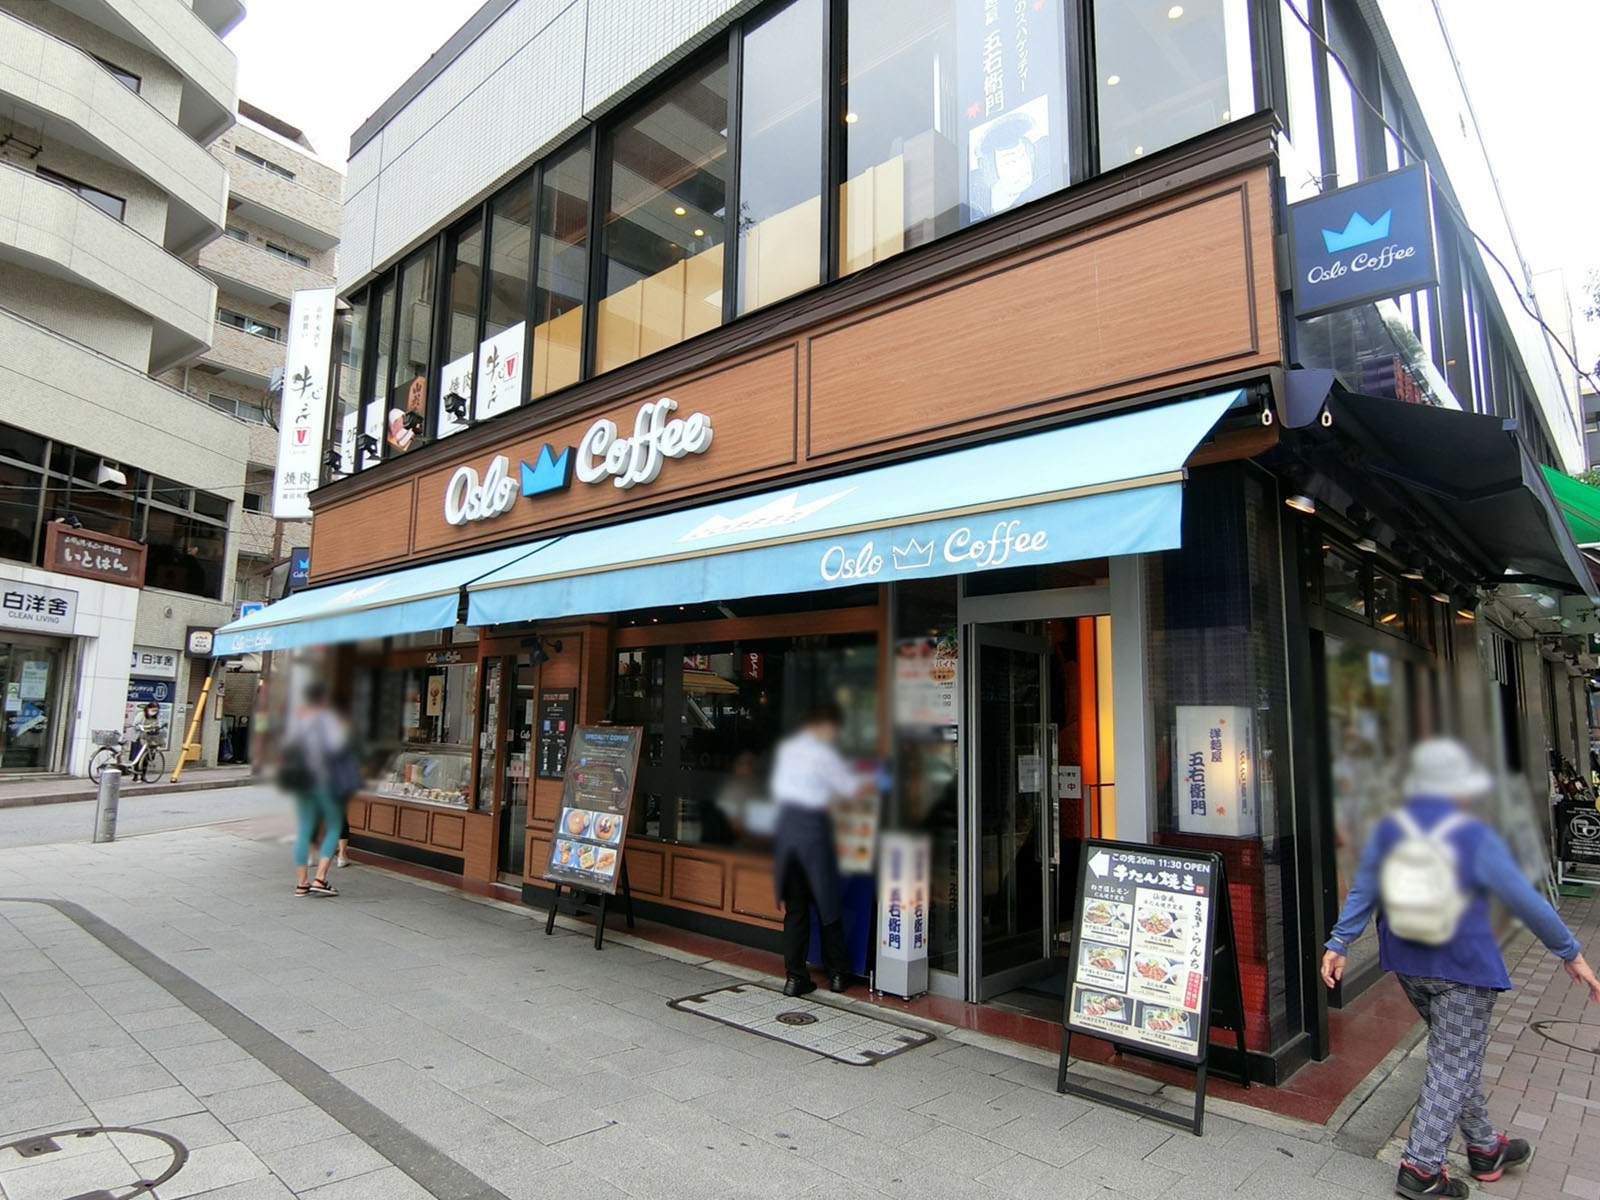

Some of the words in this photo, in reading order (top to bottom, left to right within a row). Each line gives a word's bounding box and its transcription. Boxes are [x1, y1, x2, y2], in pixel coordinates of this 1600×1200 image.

[1308, 261, 1348, 284] Oslo
[1351, 244, 1416, 272] Coffee
[444, 454, 519, 526] Oslo
[575, 397, 714, 489] Coffee
[64, 548, 129, 571] いとはん
[820, 541, 884, 581] Oslo
[944, 520, 1049, 568] Coffee
[8, 611, 34, 620] CLEAN
[36, 614, 60, 624] LIVING
[1188, 751, 1206, 816] 五右衛門
[1112, 853, 1156, 866] この先20m
[1158, 859, 1182, 869] 11:30
[1183, 862, 1210, 873] OPEN
[1113, 864, 1196, 891] 牛たん焼き
